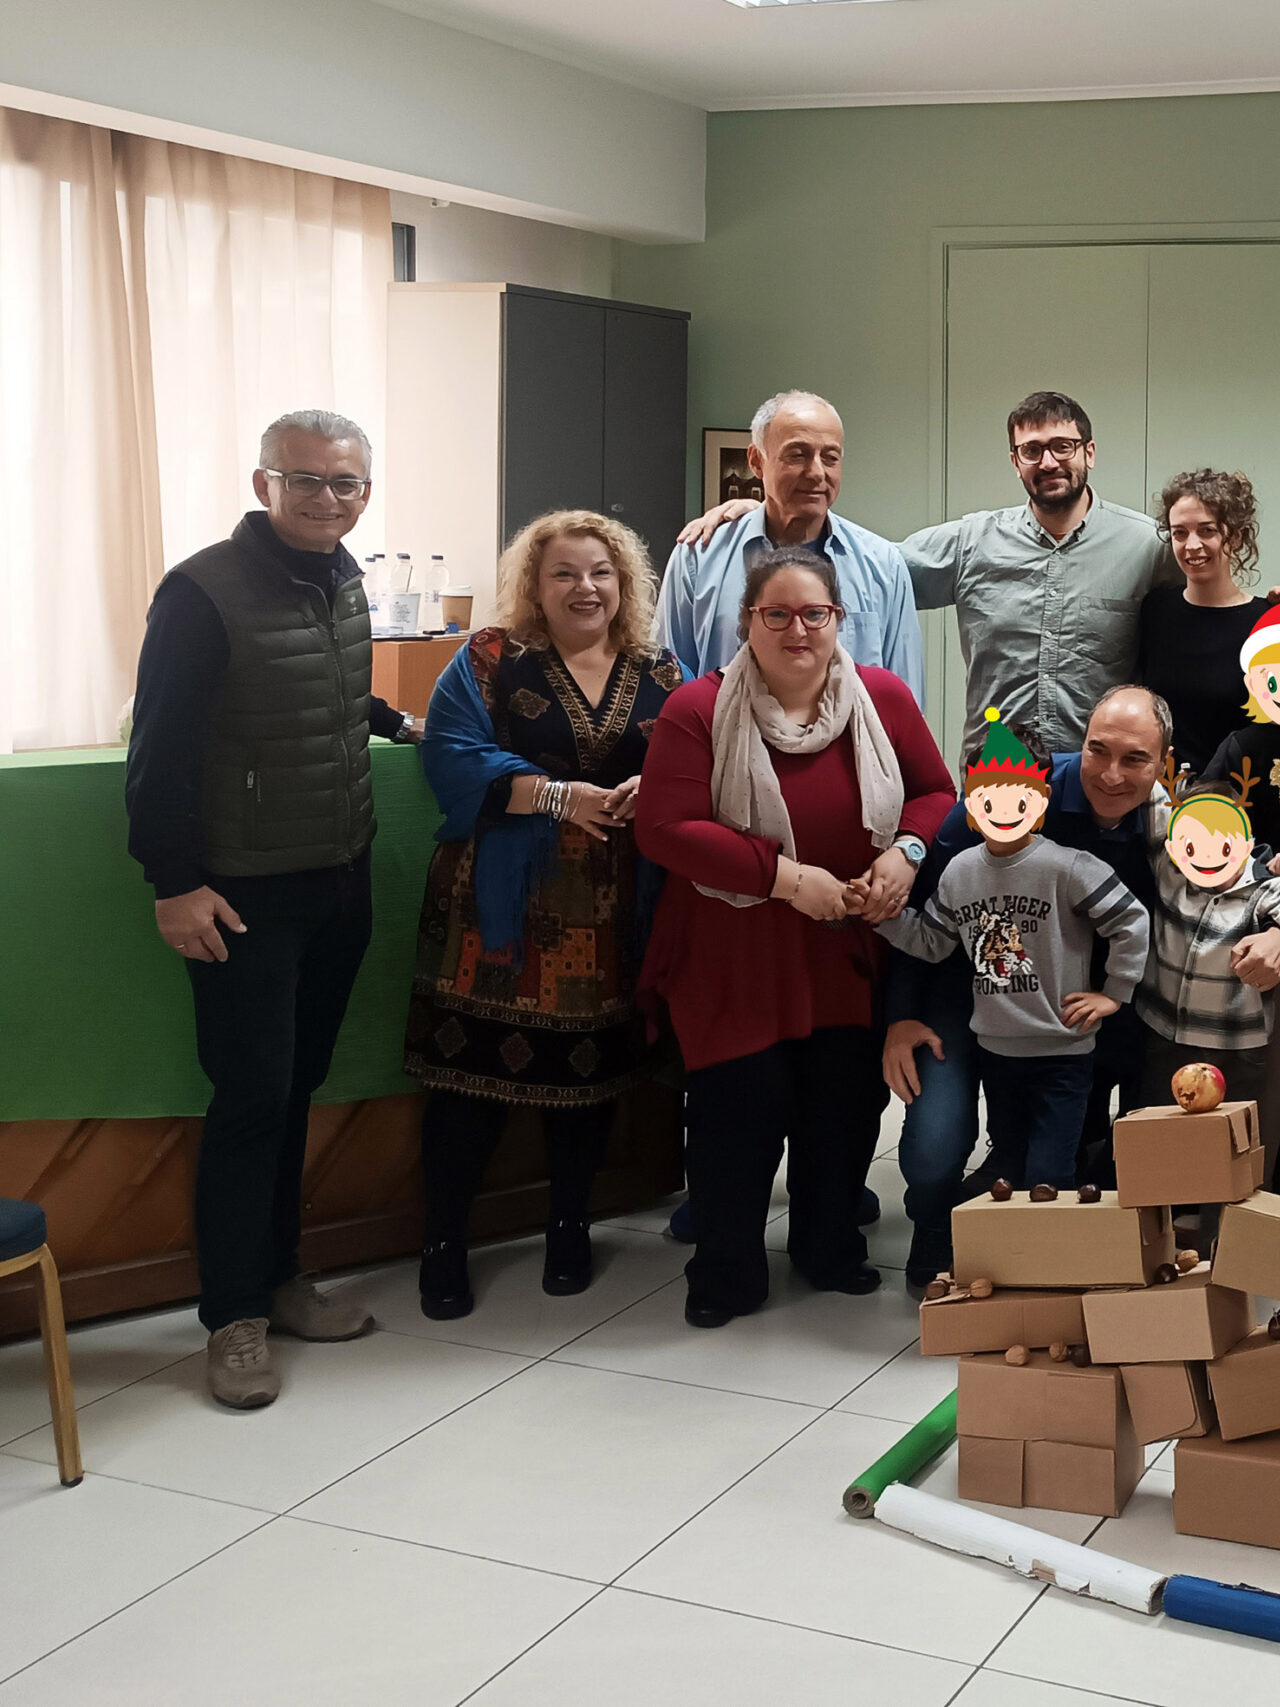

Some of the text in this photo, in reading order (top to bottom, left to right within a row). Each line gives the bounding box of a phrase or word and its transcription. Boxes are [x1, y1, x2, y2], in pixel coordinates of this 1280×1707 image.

[954, 895, 1051, 926] GREAT TIGER
[1021, 919, 1038, 934] 90
[974, 974, 1039, 996] PORING
